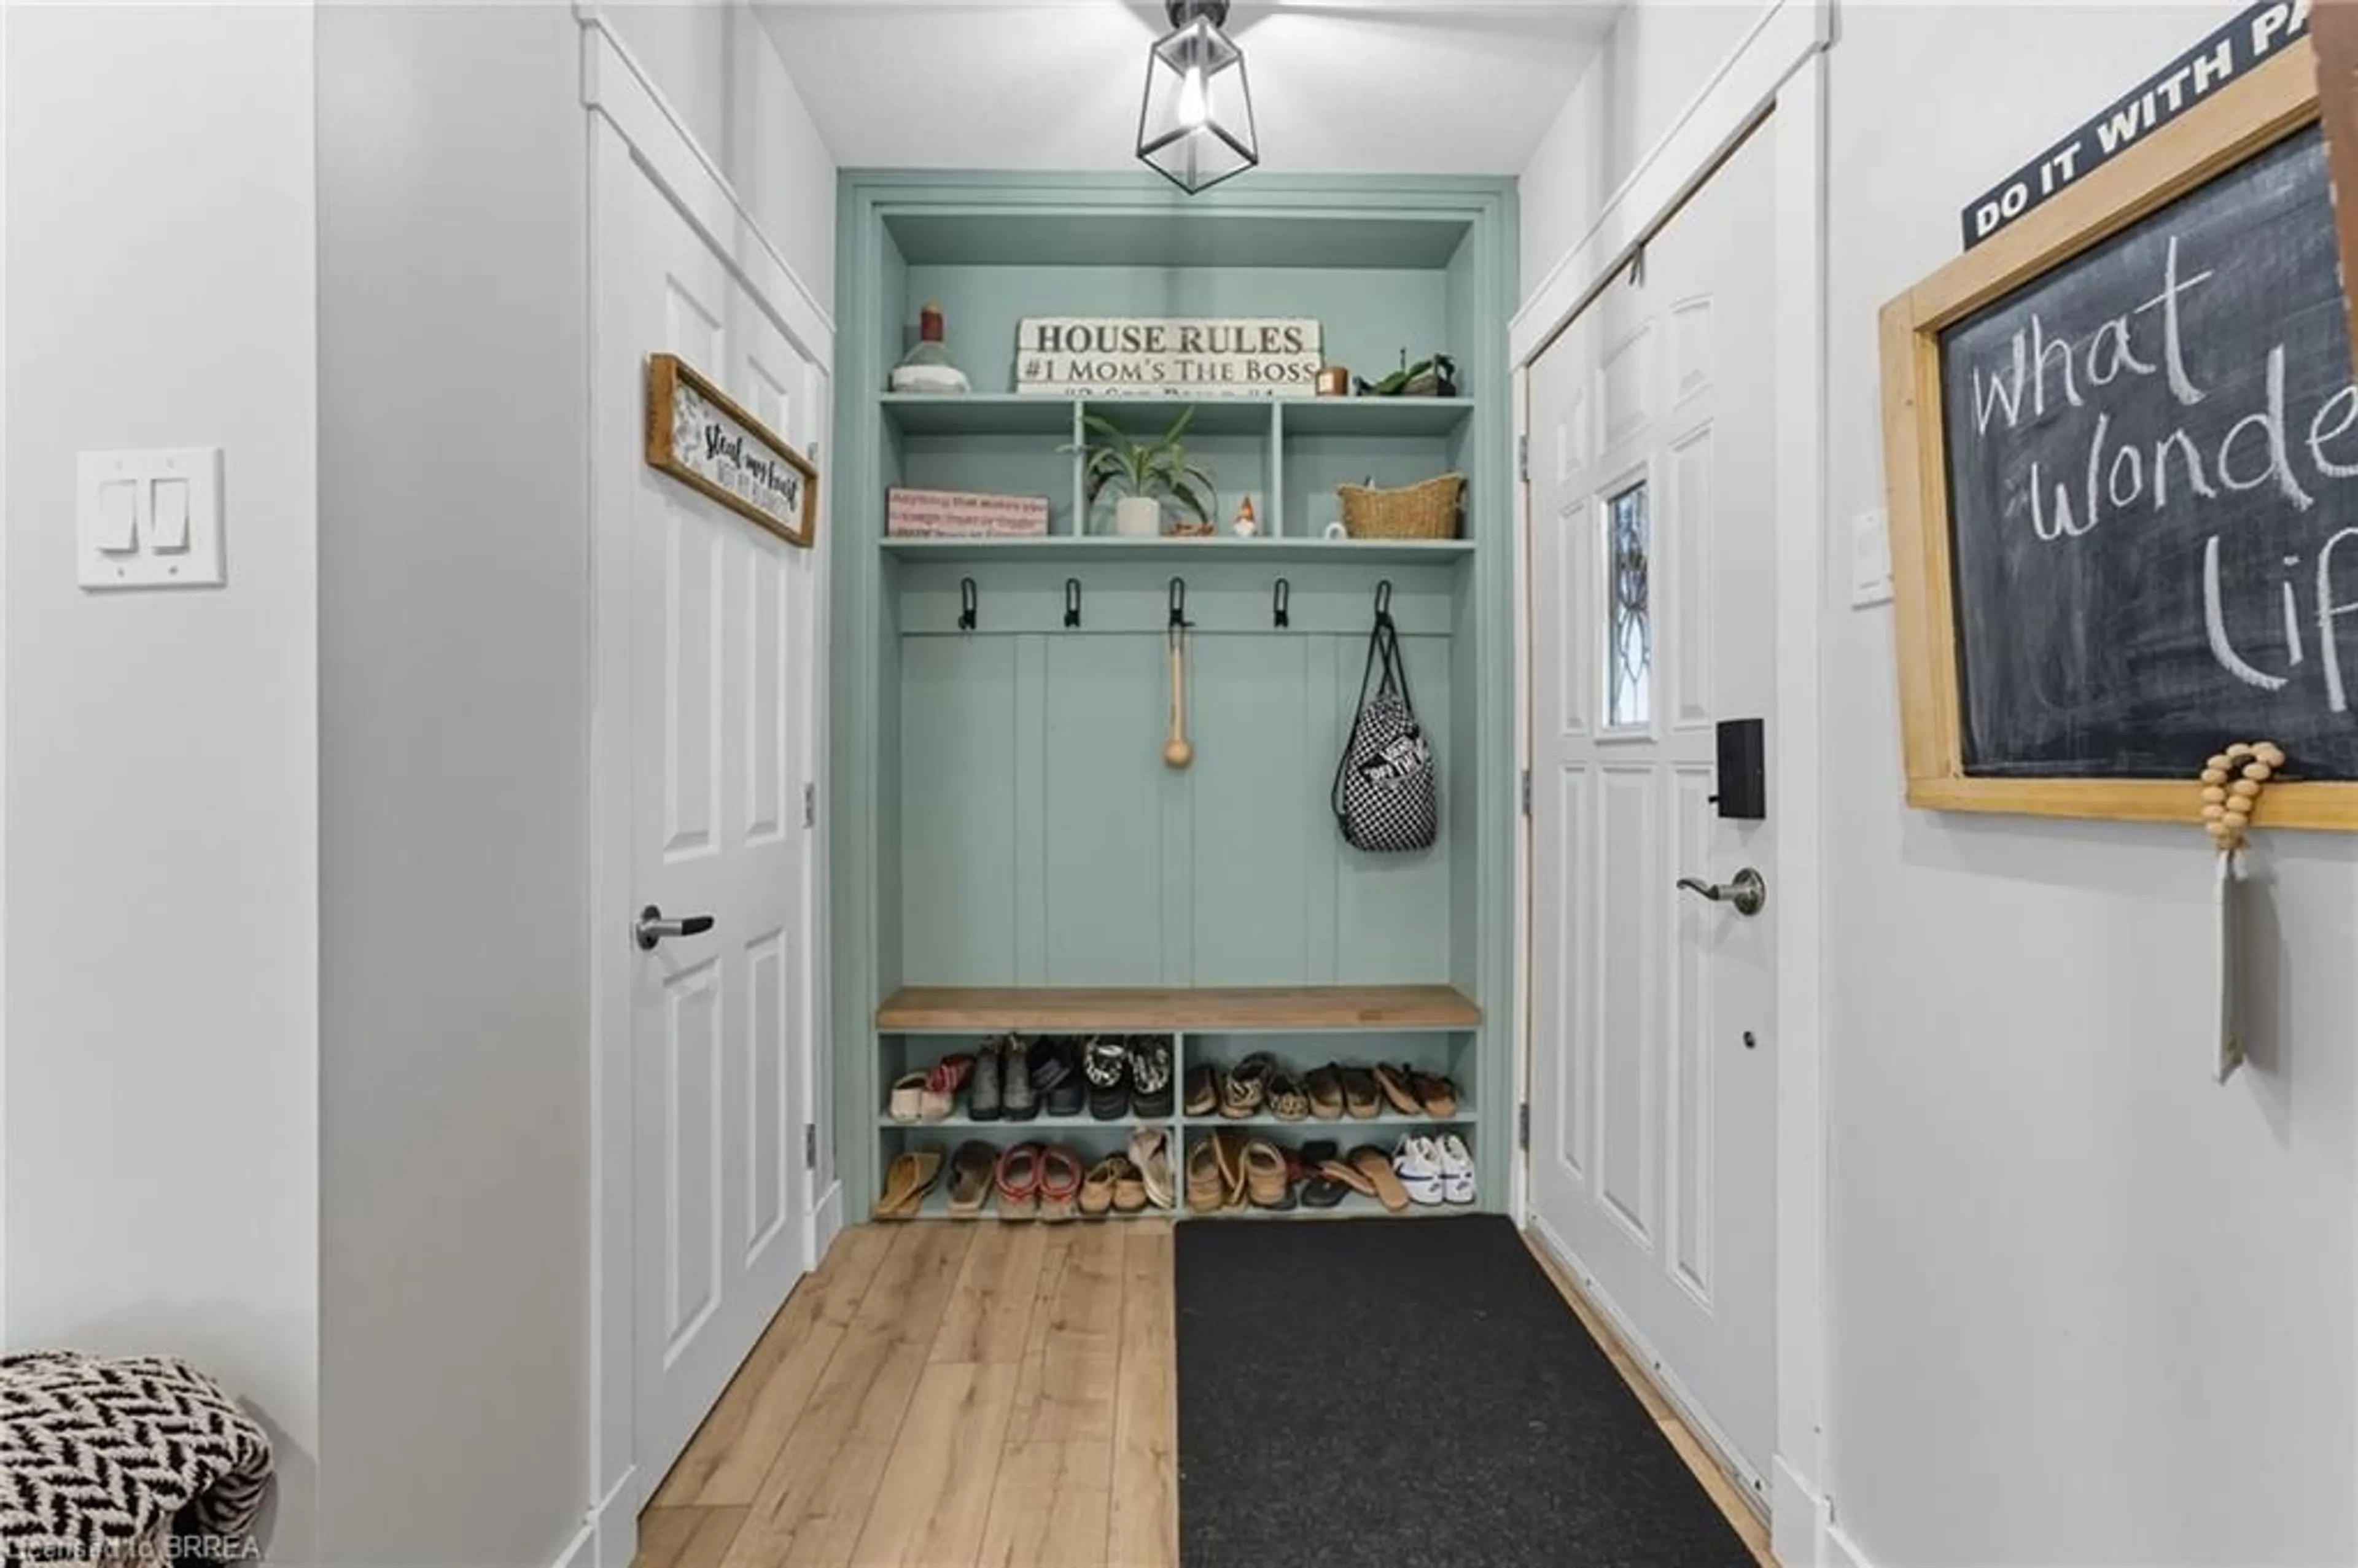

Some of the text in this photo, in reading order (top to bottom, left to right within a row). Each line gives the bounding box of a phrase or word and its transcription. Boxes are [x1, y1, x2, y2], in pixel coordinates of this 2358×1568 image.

[1975, 182, 2028, 238] DO
[2039, 141, 2082, 196] IT
[2096, 37, 2233, 153] WITH
[1038, 325, 1303, 354] HOUSE RULES
[1025, 359, 1054, 381] #1
